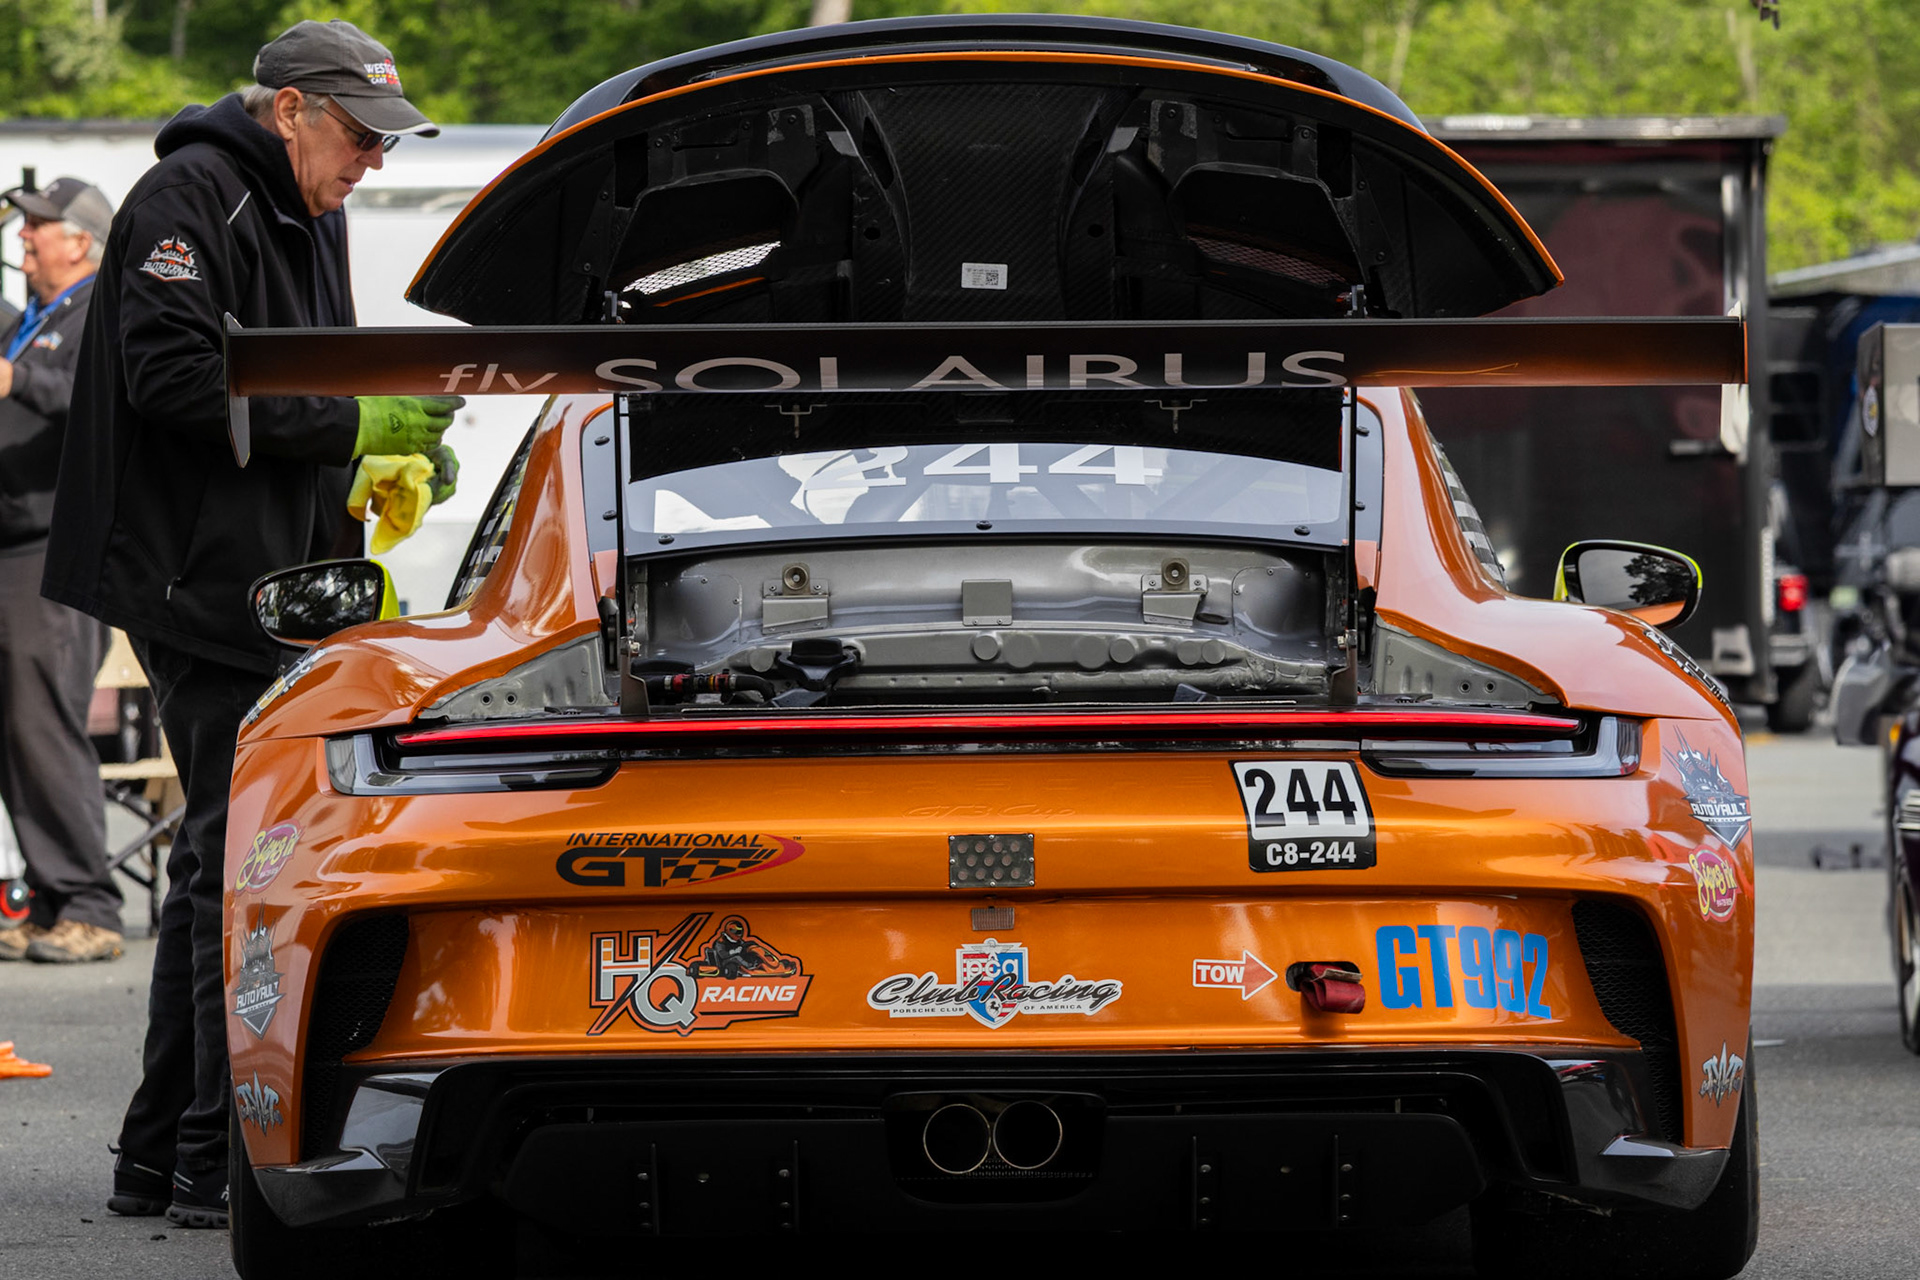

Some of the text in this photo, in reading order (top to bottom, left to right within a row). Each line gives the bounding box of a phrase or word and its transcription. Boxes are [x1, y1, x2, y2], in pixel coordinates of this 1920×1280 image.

[440, 351, 1348, 392] fly SOLAIRUS
[1244, 768, 1358, 828] 244
[566, 833, 765, 848] INTERNATIONAL
[1266, 841, 1357, 866] C8-244
[556, 847, 694, 888] GT
[872, 972, 1119, 1009] Club Racing
[1197, 964, 1246, 984] TOW
[1375, 924, 1552, 1020] GT992
[700, 985, 797, 1003] RACING
